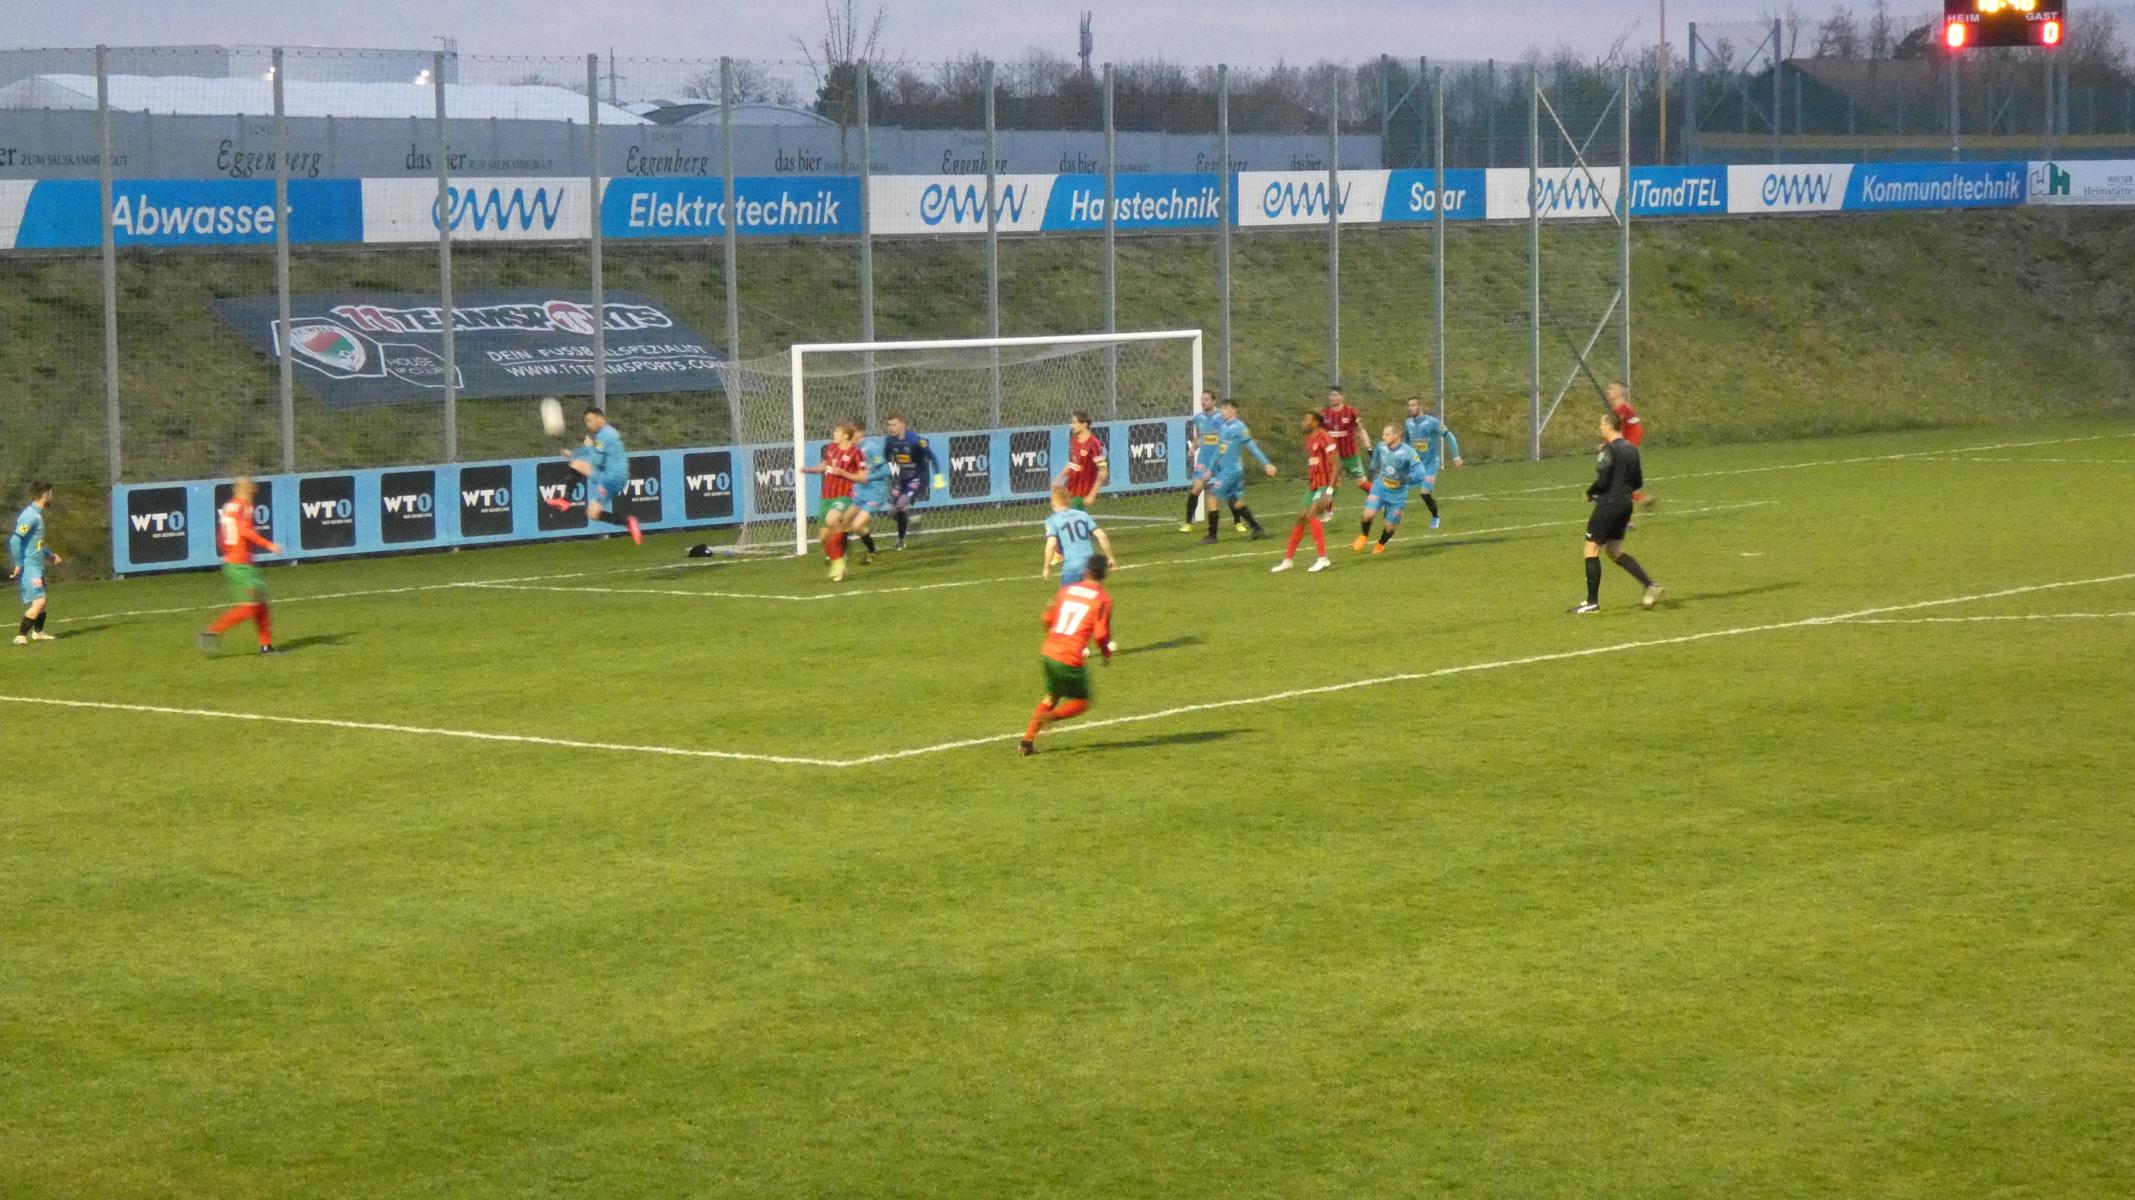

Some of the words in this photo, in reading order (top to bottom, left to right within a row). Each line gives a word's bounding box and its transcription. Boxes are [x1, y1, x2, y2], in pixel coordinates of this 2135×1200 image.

[1947, 13, 1980, 22] HEIM
[2026, 12, 2057, 21] GAST
[1947, 23, 1965, 47] 0
[2043, 22, 2059, 44] 0
[217, 139, 322, 178] Eggenerg
[406, 144, 431, 170] das
[436, 144, 466, 170] ier
[626, 145, 708, 176] Eggenberg
[775, 148, 795, 171] das
[798, 148, 822, 171] bier
[942, 149, 1008, 174] Eggenbrg
[1410, 182, 1466, 211] Soar
[1862, 172, 2020, 202] Kommunaltechnik
[486, 349, 533, 362] DEIN
[539, 344, 708, 359] FUSSBLLSPEZIALIST
[1061, 519, 1089, 542] 10
[1055, 600, 1091, 636] 17
